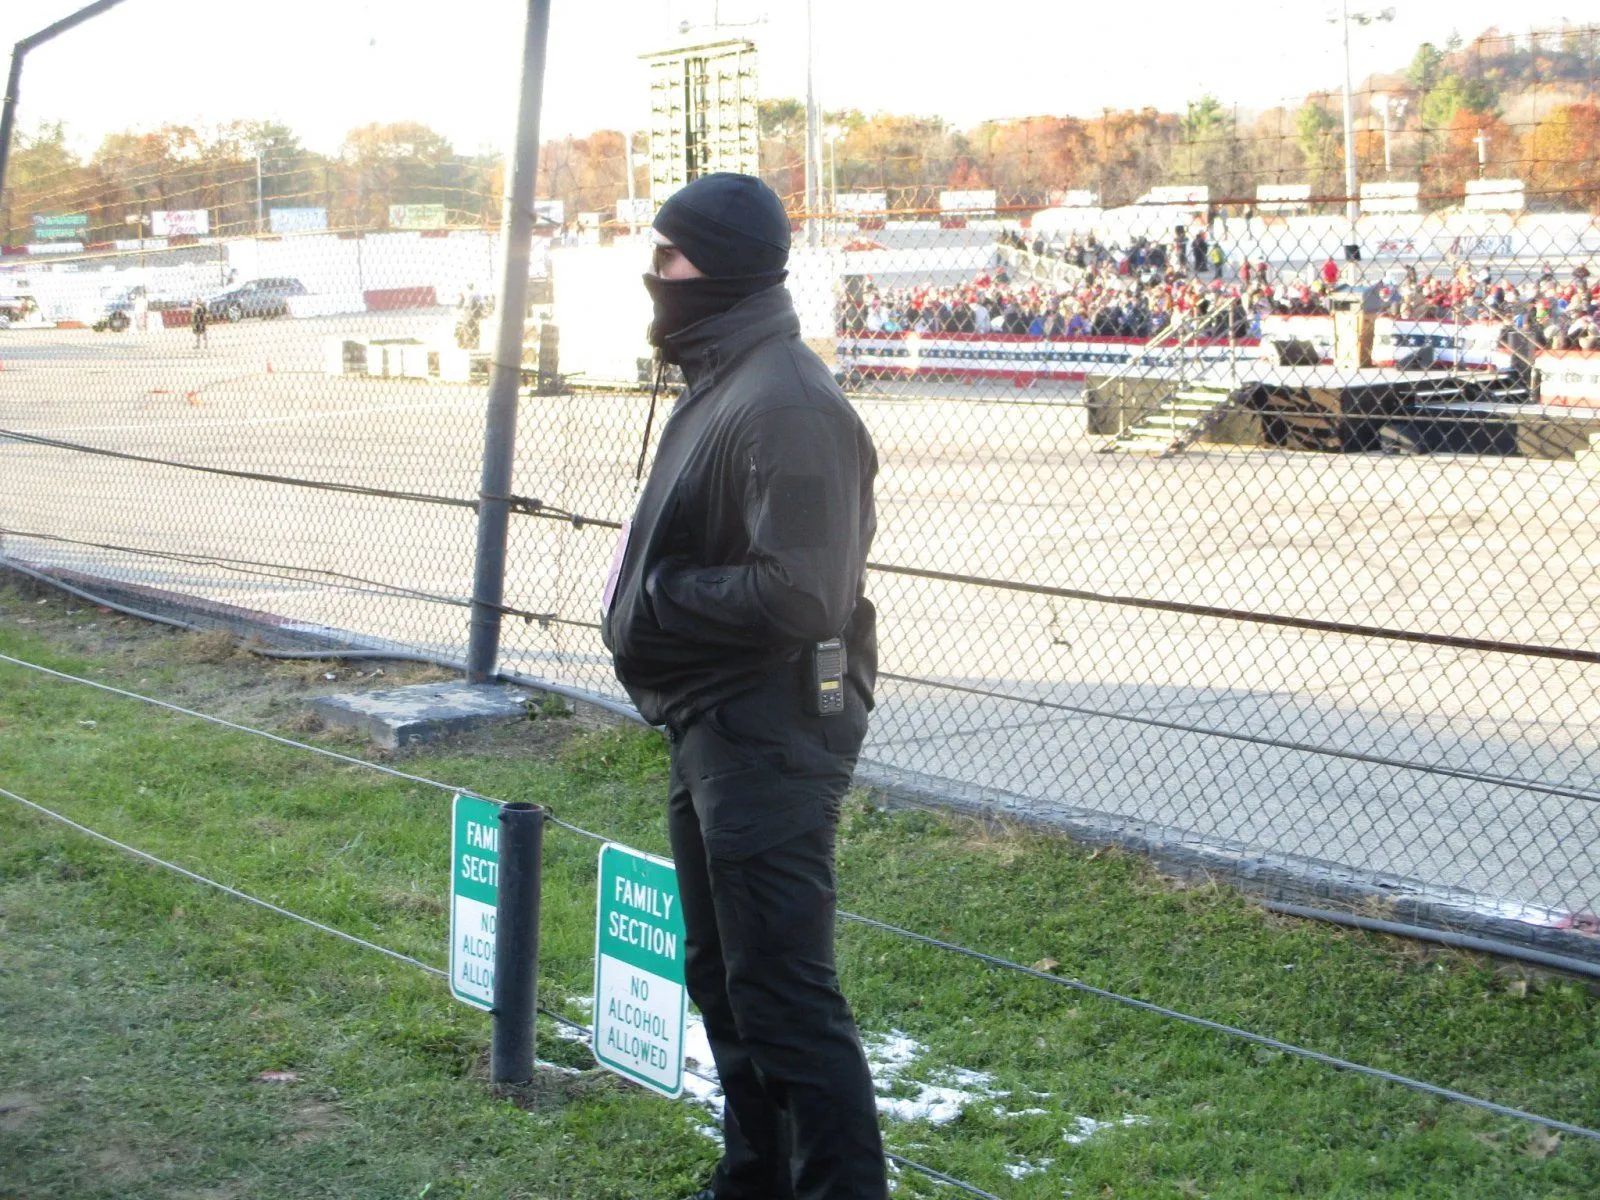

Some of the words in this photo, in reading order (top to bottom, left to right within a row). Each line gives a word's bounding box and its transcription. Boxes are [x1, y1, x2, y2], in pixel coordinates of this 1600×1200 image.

[467, 820, 498, 852] FAMI
[461, 854, 499, 888] SECTI
[615, 876, 674, 920] FAMILY
[481, 911, 497, 934] NO
[609, 911, 677, 960] SECTION
[630, 975, 650, 1001] NO
[608, 997, 670, 1041] ALCOHOL
[607, 1026, 668, 1070] ALLOWED
